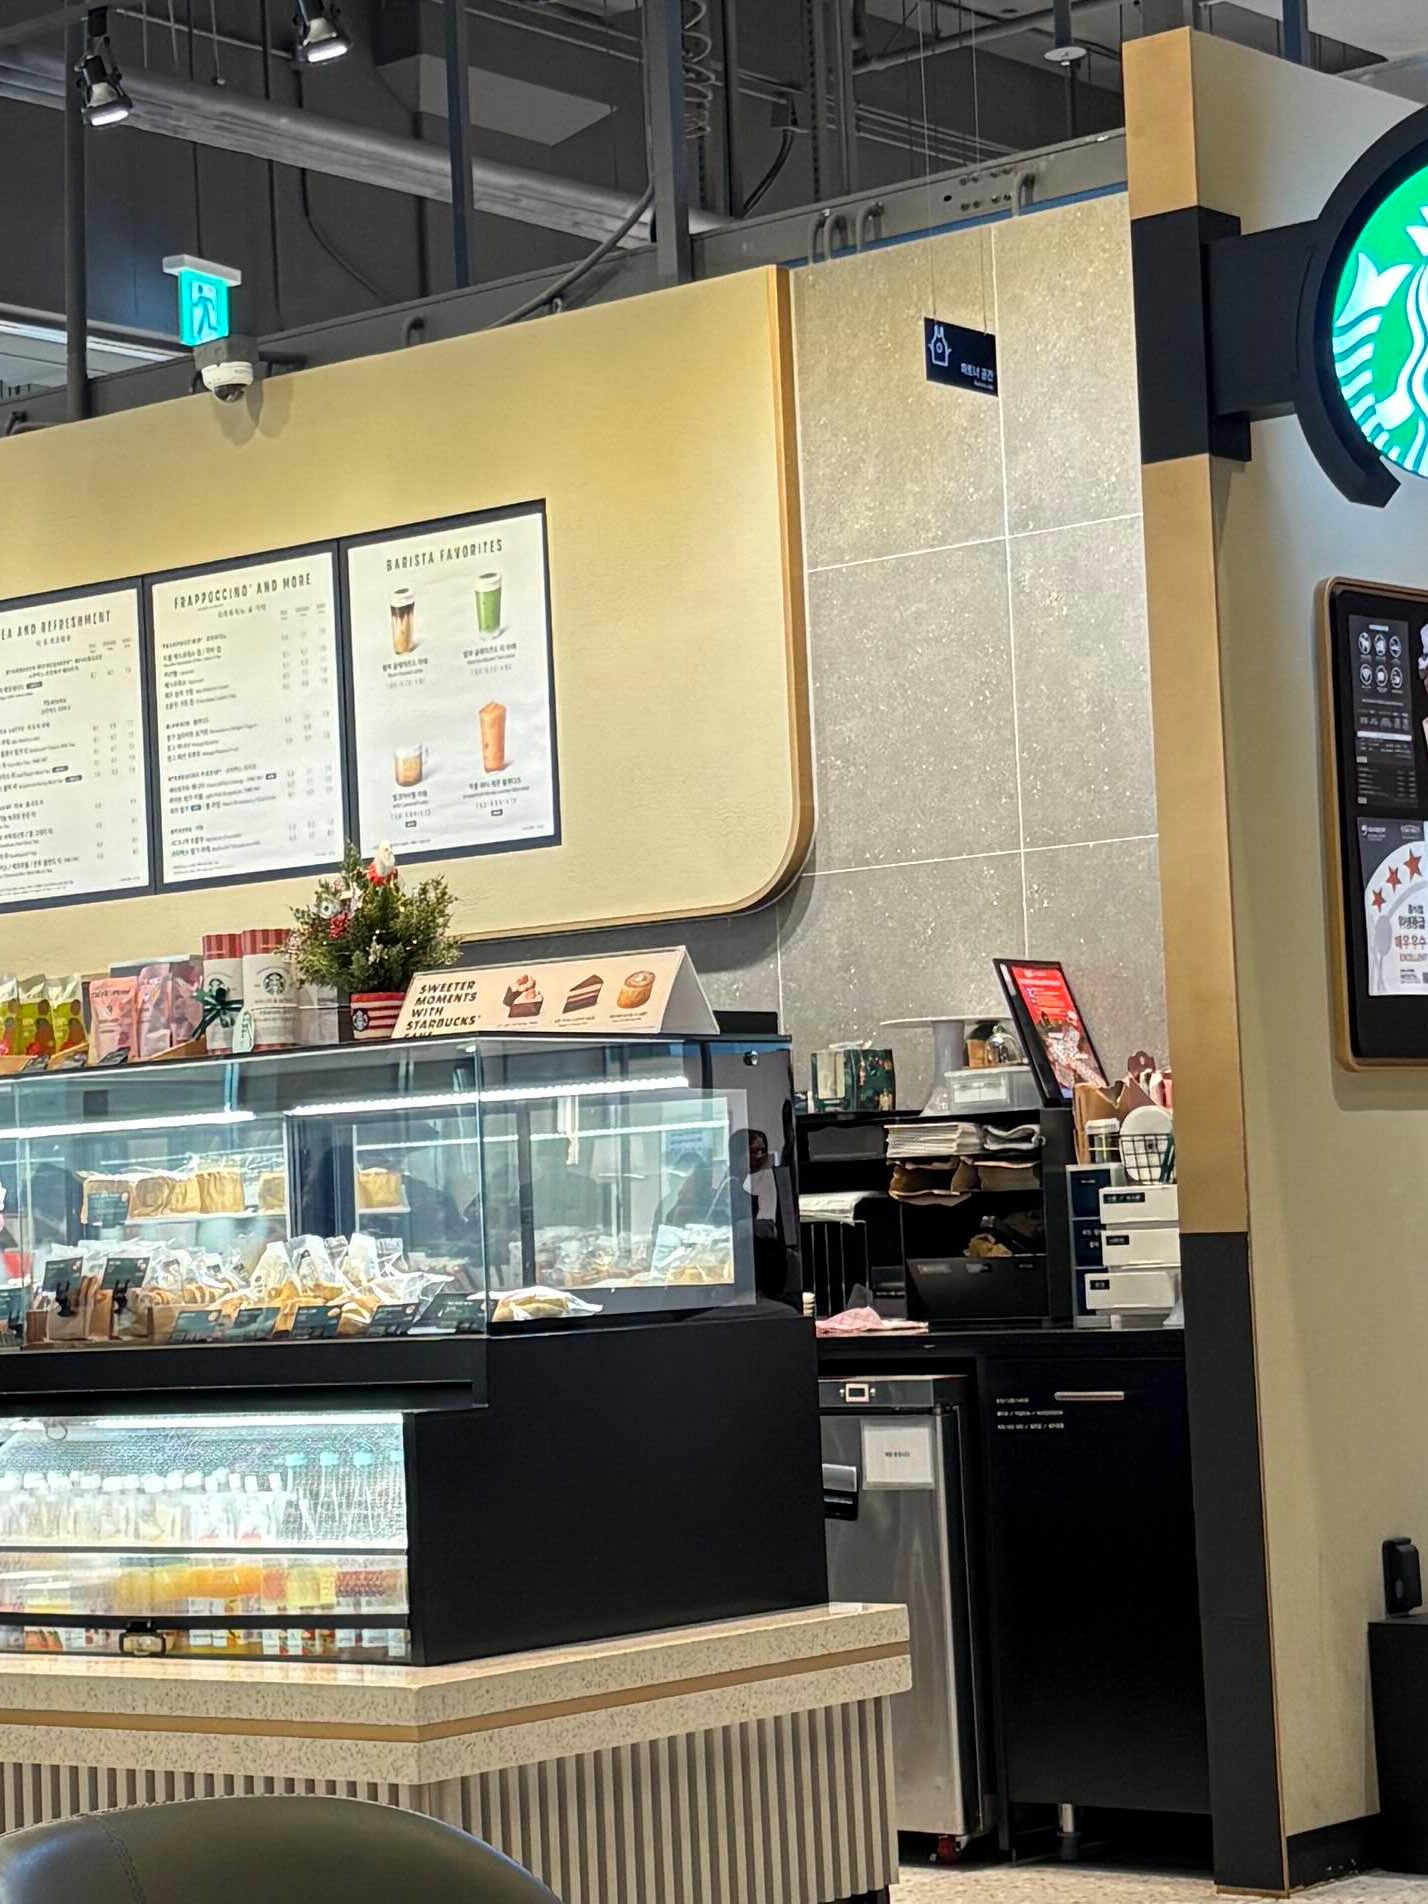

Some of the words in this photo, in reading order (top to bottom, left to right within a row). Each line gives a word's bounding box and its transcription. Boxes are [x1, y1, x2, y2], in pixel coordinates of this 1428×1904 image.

[386, 552, 434, 572] BARISTA
[440, 539, 503, 562] FAVORITES
[256, 579, 278, 594] AND
[283, 573, 312, 589] MORE
[17, 623, 36, 637] AND
[41, 610, 111, 633] REFRESHMENT
[420, 980, 476, 994] SWEETER
[415, 992, 477, 1006] MOMENTS
[412, 1007, 443, 1018] WITH
